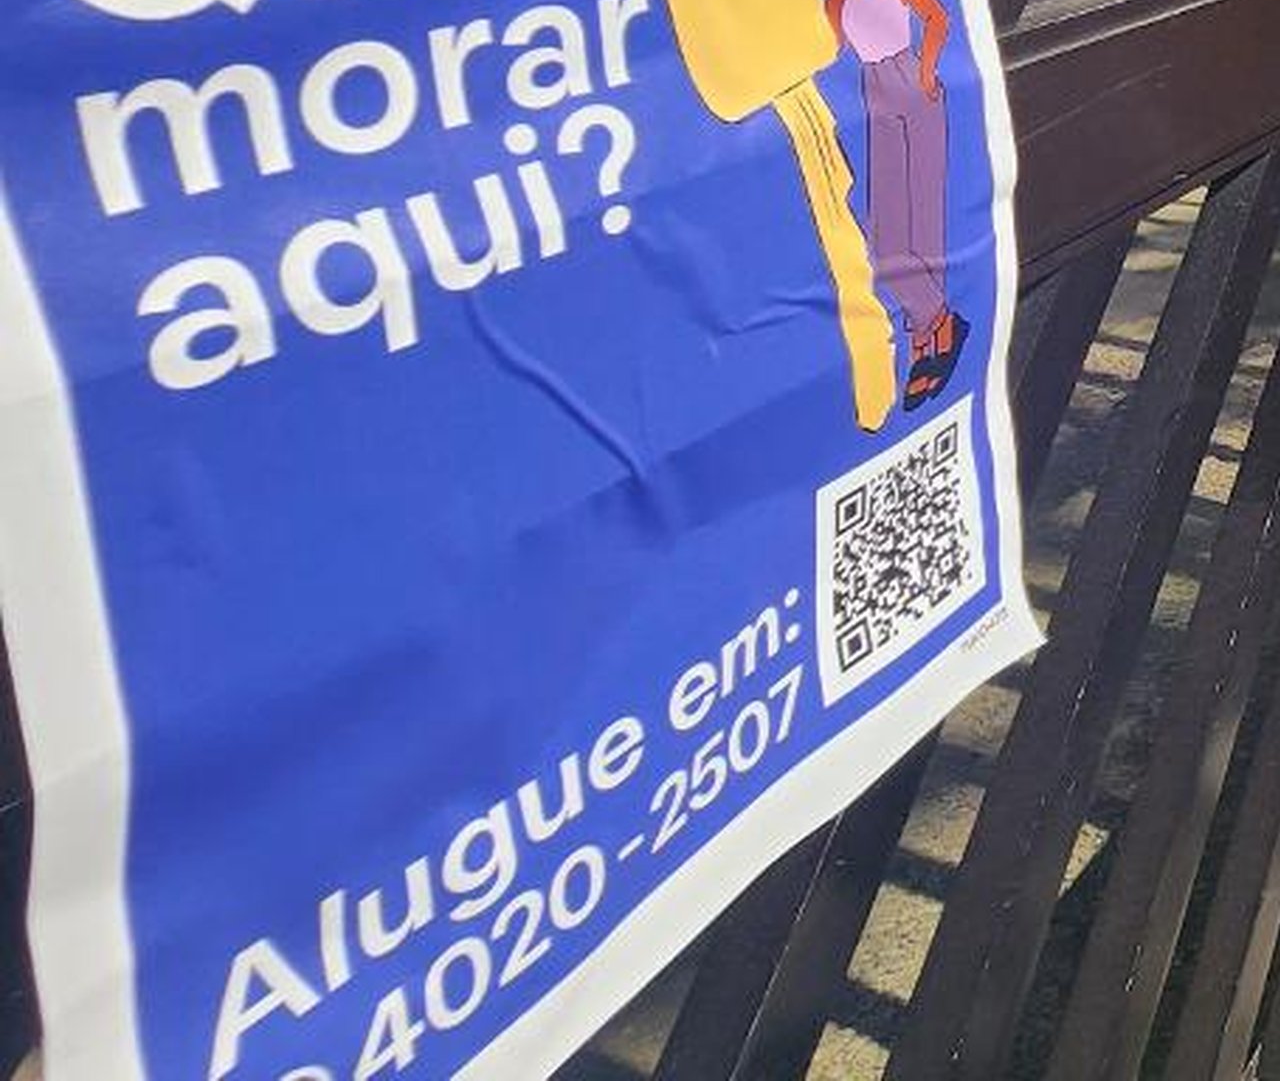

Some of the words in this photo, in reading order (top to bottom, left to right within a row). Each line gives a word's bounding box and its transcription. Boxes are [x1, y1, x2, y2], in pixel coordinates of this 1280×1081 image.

[136, 103, 638, 391] aqui?
[207, 714, 644, 1077] Alugue
[669, 587, 801, 734] em:
[352, 663, 804, 1081] 4020-2507
